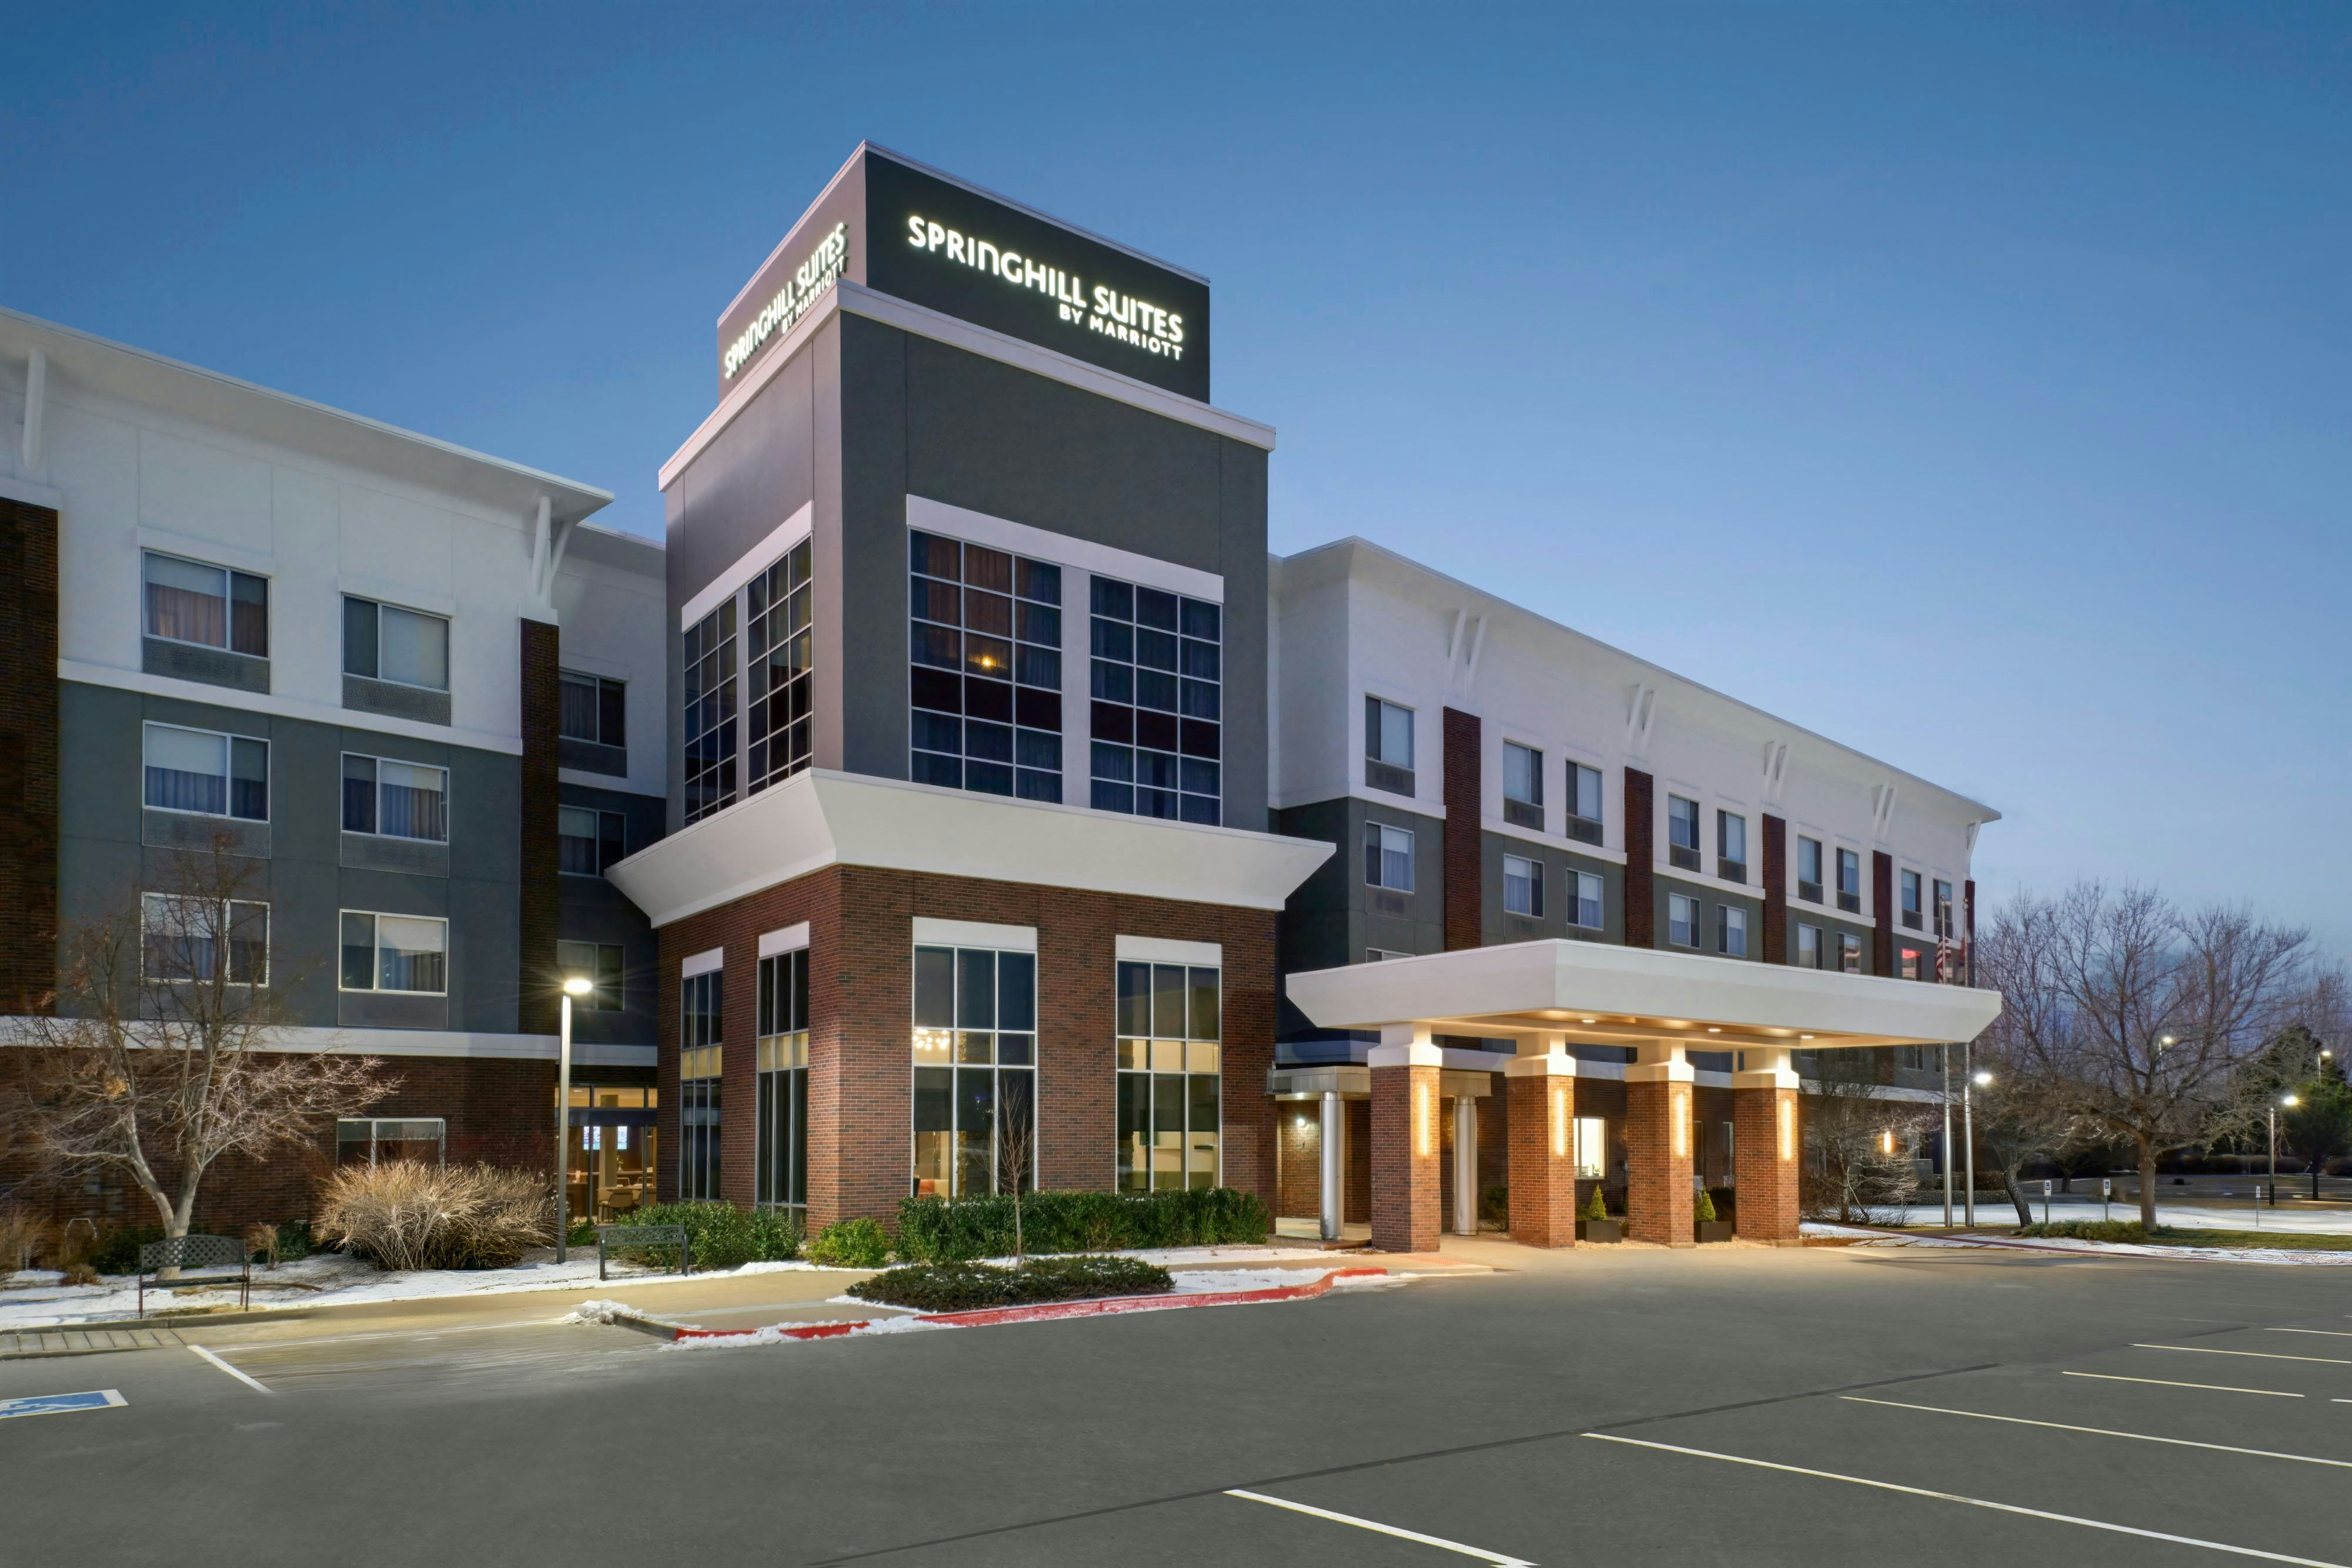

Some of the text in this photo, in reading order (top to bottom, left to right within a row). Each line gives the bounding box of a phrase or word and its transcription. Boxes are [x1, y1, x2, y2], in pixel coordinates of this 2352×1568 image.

[724, 222, 846, 379] SPRINGHILL SUITES
[781, 255, 844, 334] BY MARRIOTT
[908, 215, 1184, 343] SPRINGHILL SUITES
[1059, 303, 1183, 361] BY MARRIOTT
